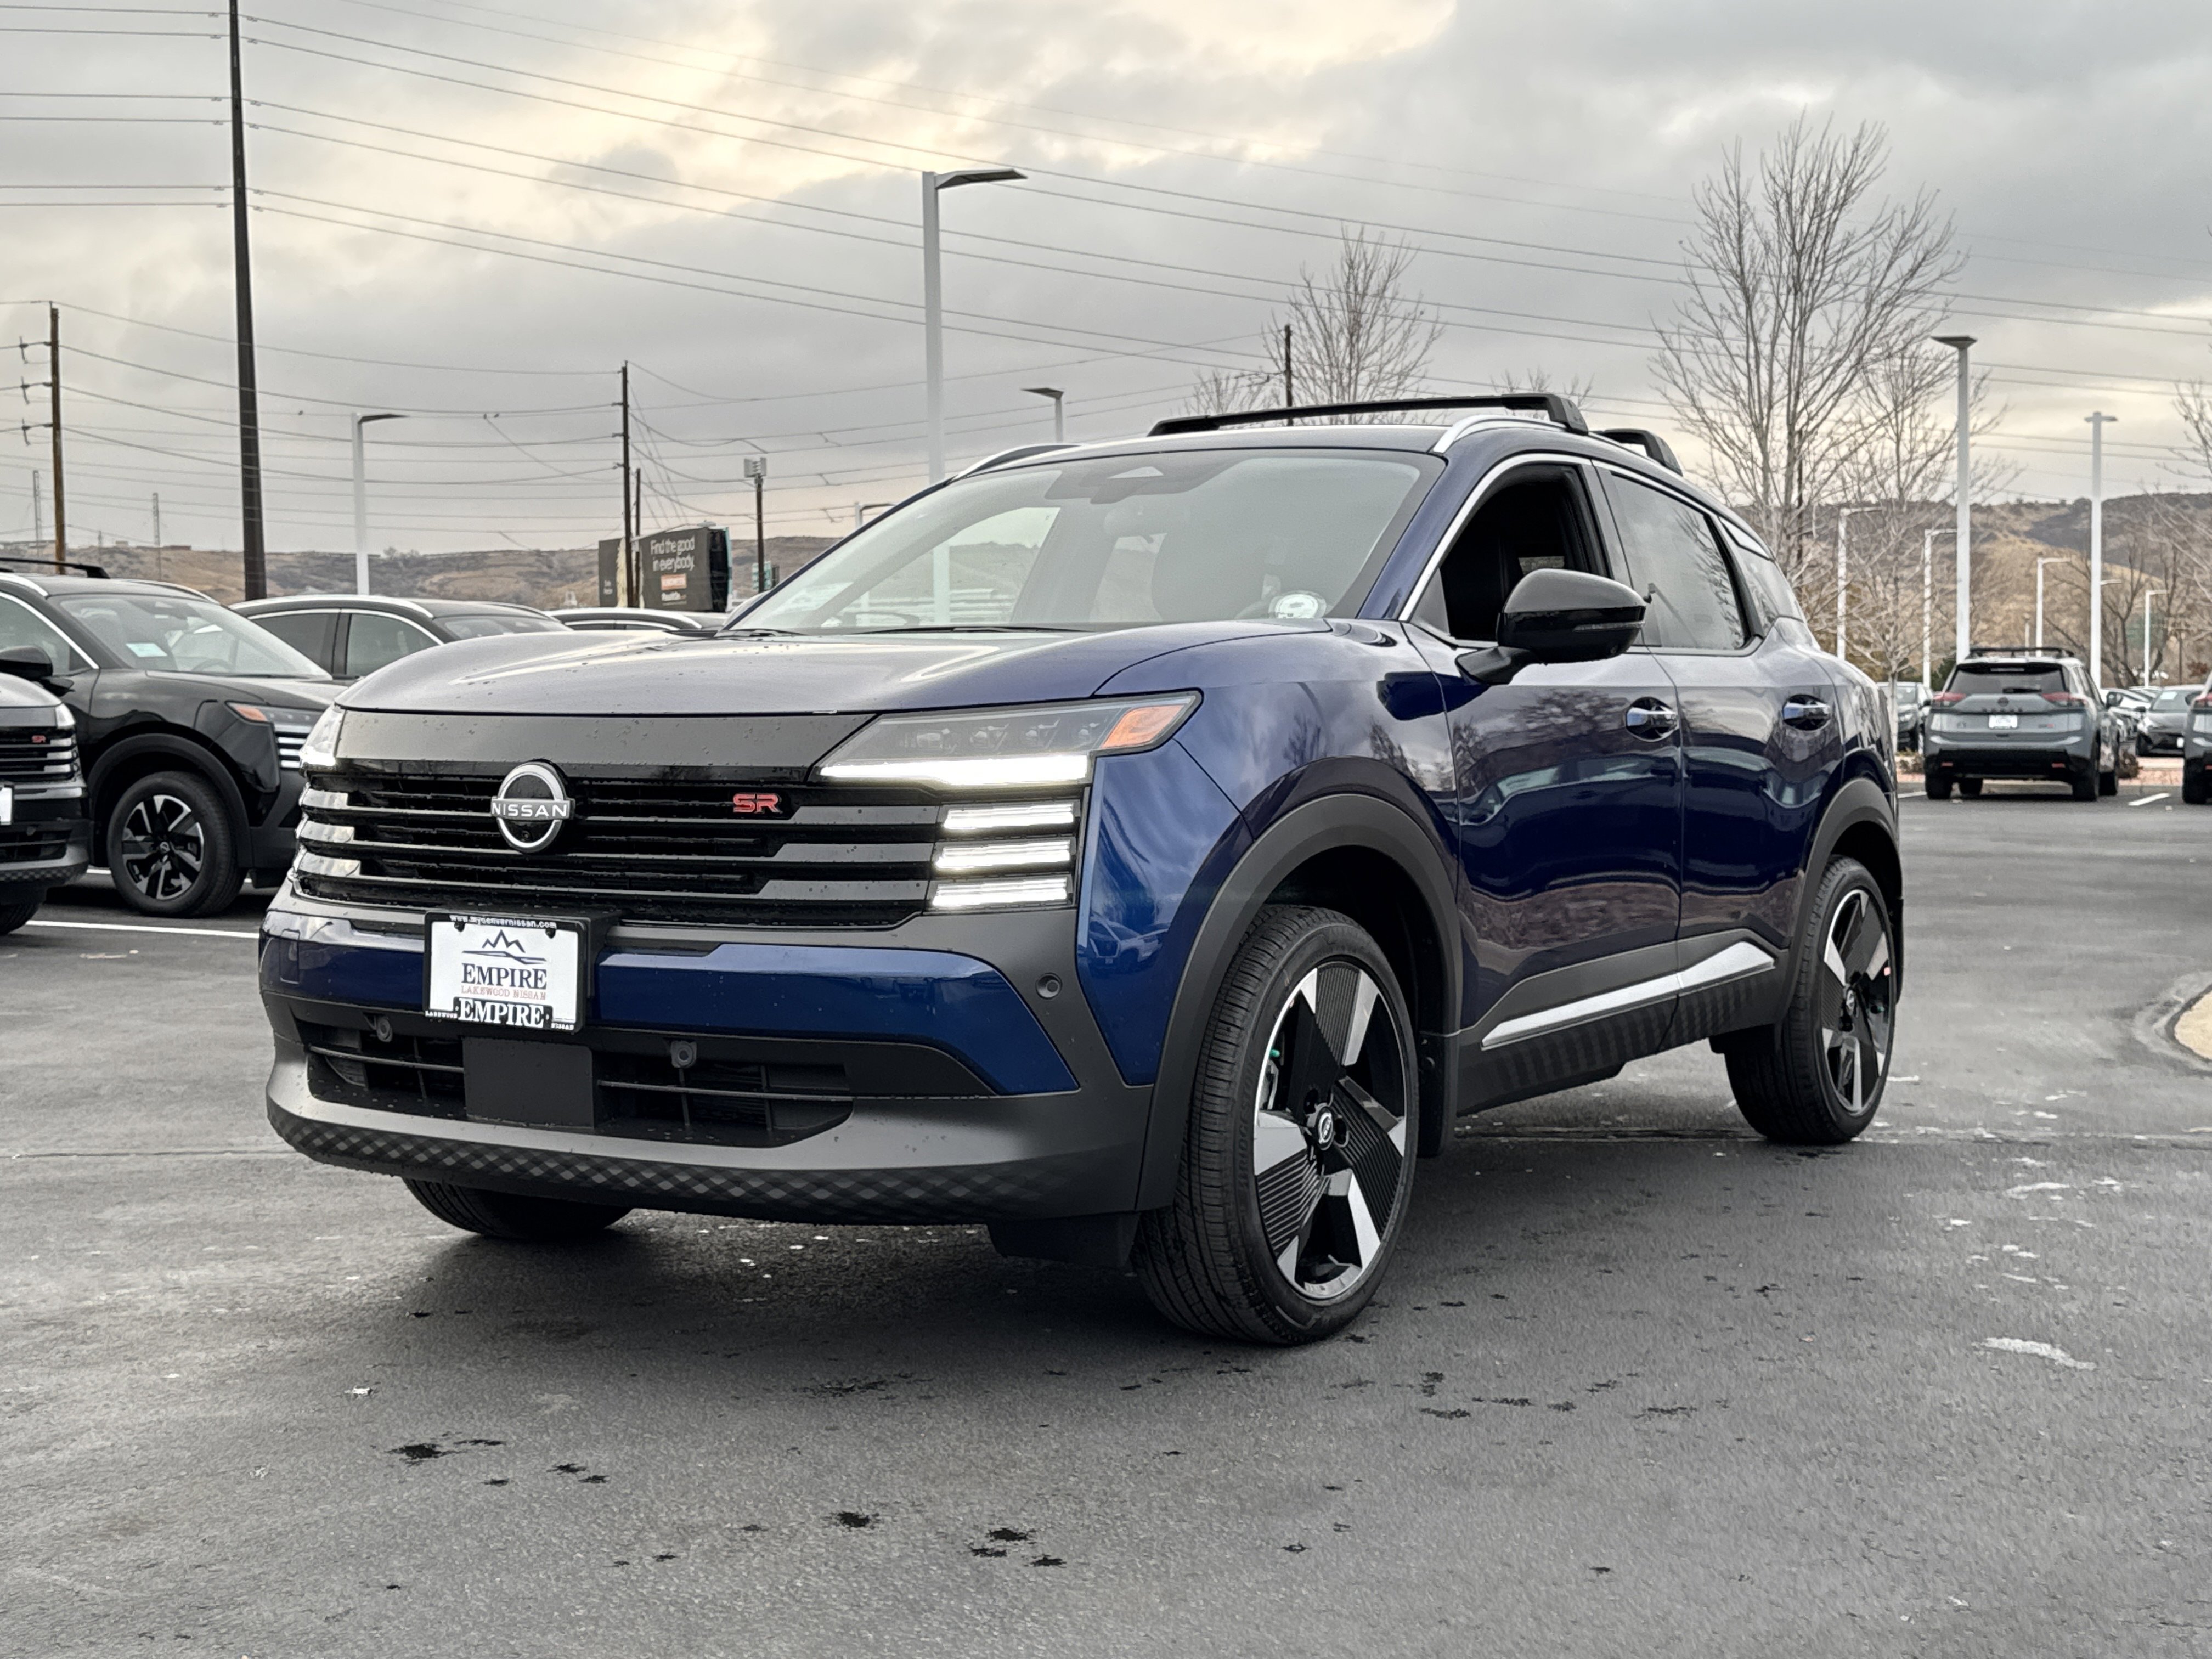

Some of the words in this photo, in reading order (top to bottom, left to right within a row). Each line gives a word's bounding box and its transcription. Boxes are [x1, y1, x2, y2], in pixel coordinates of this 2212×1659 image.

[650, 539, 665, 554] Find
[665, 539, 676, 554] the
[676, 536, 695, 555] good
[652, 556, 659, 572] in
[492, 802, 567, 817] NISSAN
[733, 793, 783, 814] SR
[461, 963, 547, 990] EMPIRE
[461, 985, 510, 997] LAKEWOOD
[514, 990, 546, 1000] NISSAN
[458, 998, 544, 1028] EMPIRE
